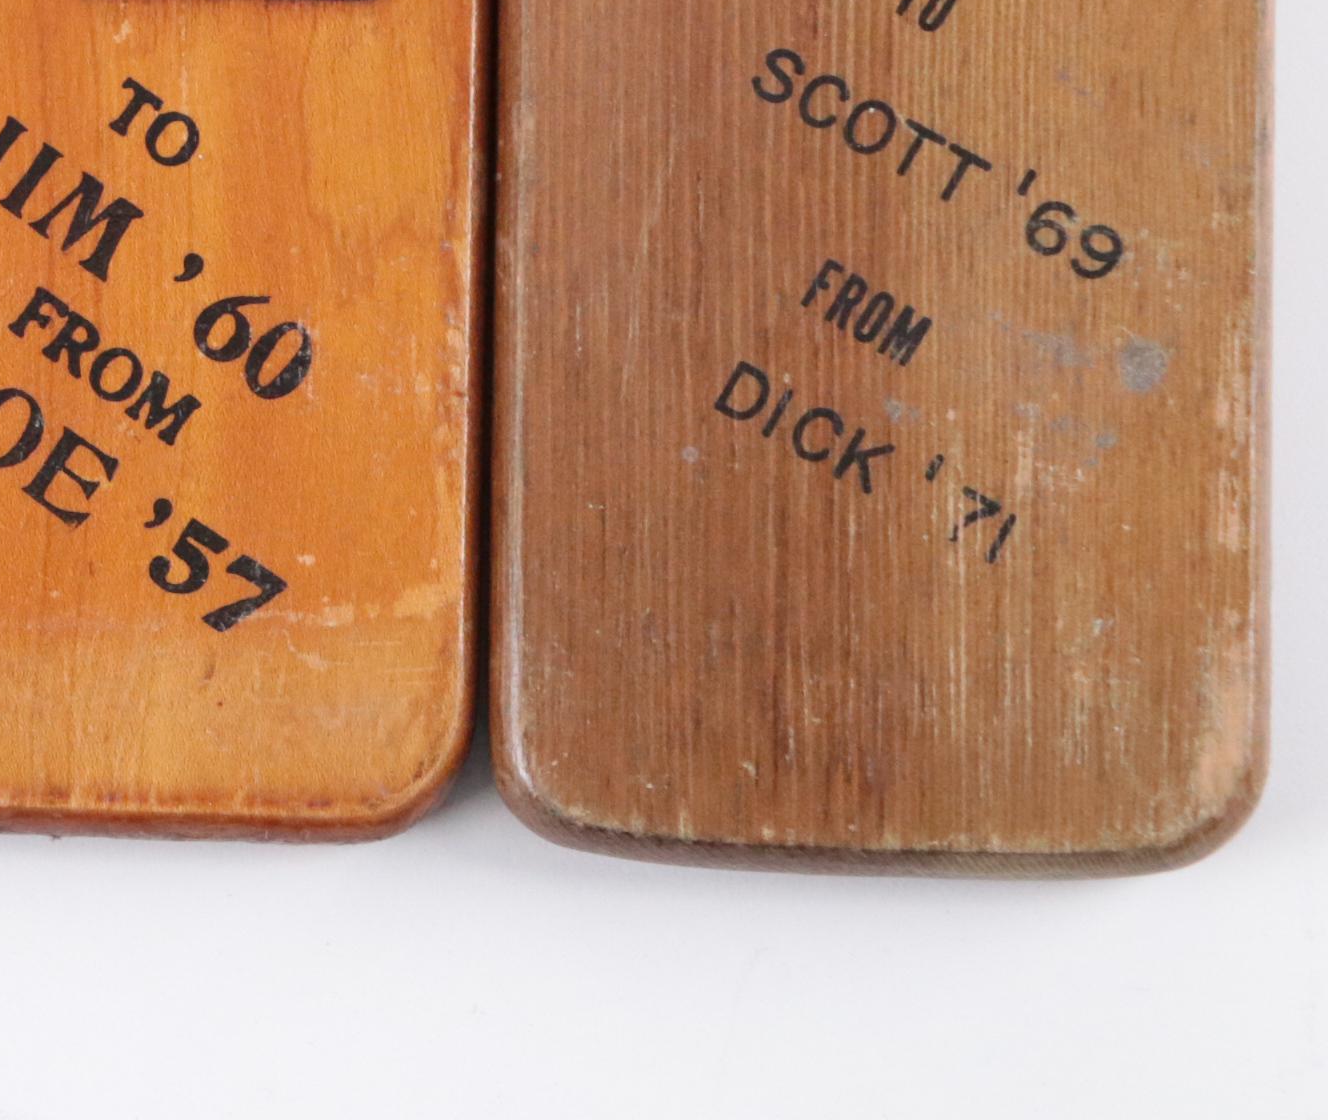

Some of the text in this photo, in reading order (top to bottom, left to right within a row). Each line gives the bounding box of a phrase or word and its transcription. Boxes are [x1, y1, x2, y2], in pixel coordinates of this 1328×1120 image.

[109, 77, 199, 166] TO
[751, 48, 992, 201] SCOTT
[8, 286, 202, 445] FROM
[802, 259, 932, 366] FROM
[714, 361, 895, 494] DICK
[144, 498, 288, 632] '57
